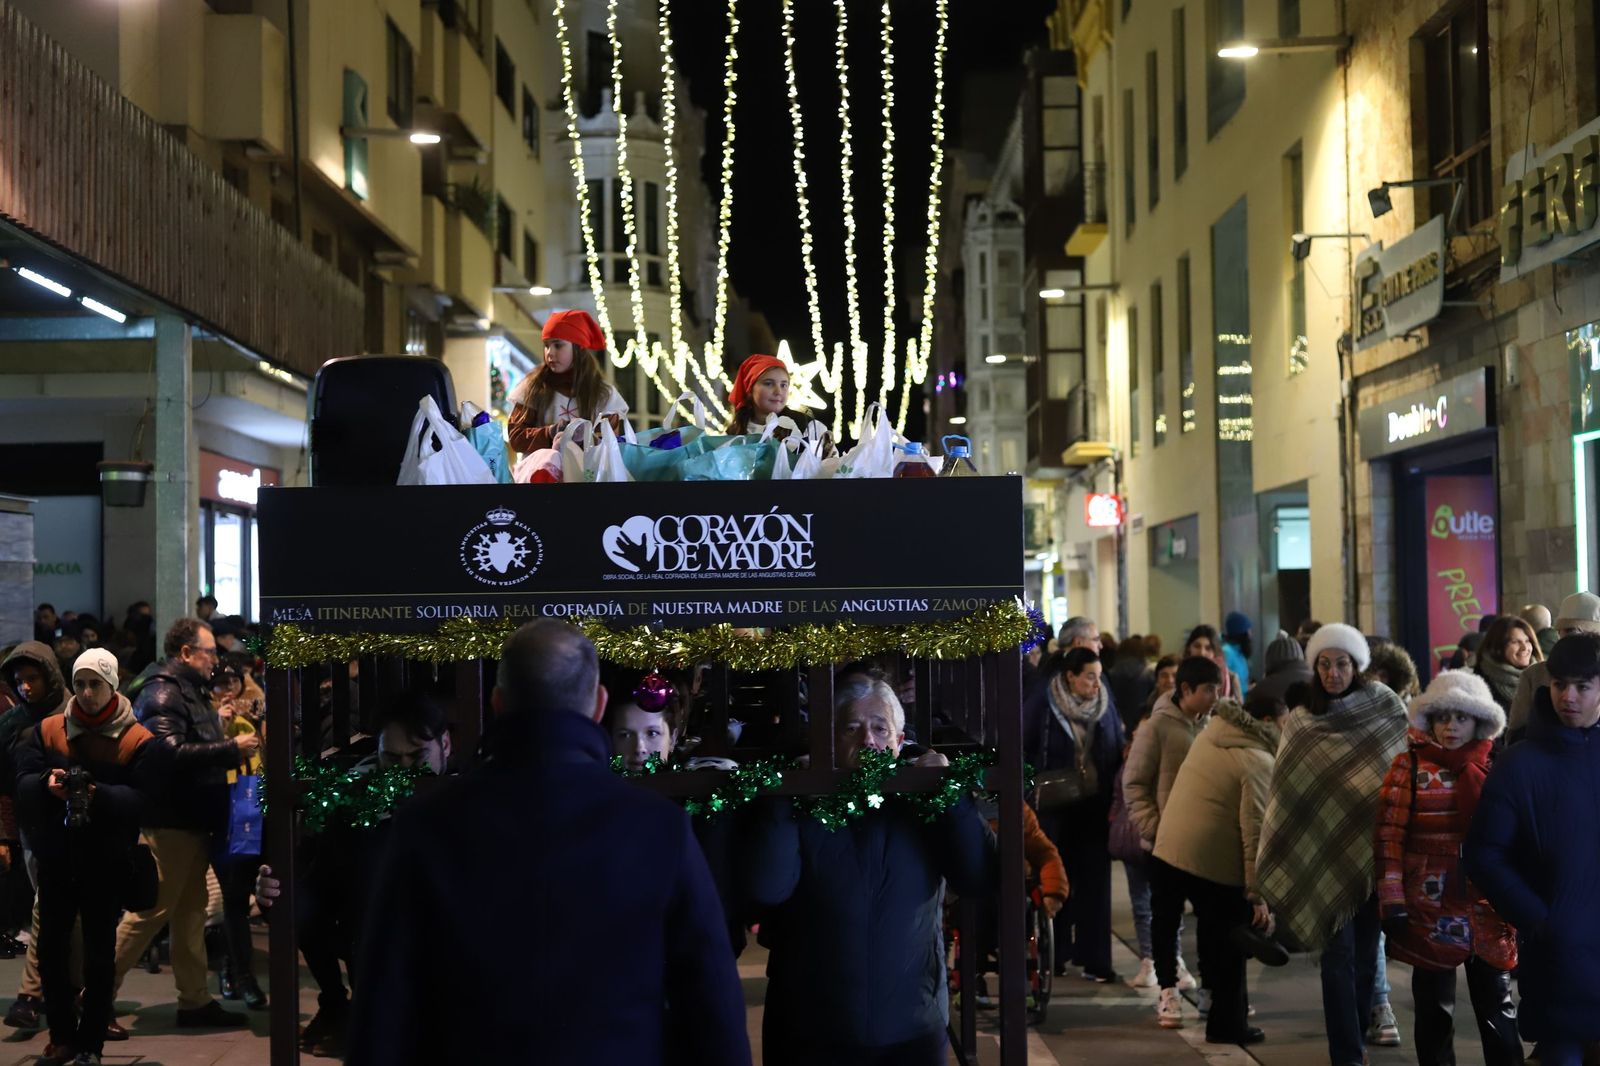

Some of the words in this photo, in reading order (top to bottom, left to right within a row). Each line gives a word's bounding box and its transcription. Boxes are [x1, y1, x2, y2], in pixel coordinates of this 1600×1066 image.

[514, 521, 531, 533] REAL
[653, 505, 814, 544] CORAZÓN
[460, 521, 488, 551] ANGUSTIAS
[654, 542, 702, 572] DE
[704, 541, 817, 571] MADRE
[465, 567, 474, 575] DE
[529, 567, 538, 575] DE
[474, 574, 497, 586] MADRE
[499, 574, 529, 586] NUESTRA
[272, 607, 314, 621] MESA
[318, 606, 412, 620] ITINERANTE
[416, 605, 499, 619] SOLIDARIA
[504, 604, 539, 617] REAL
[542, 600, 624, 617] COFRADÍA
[628, 603, 648, 615] DE
[652, 602, 724, 616] NUESTRA
[727, 600, 783, 613] MADRE
[788, 600, 807, 613] DE
[812, 600, 837, 612] LAS
[840, 598, 928, 613] ANGUSTIAS
